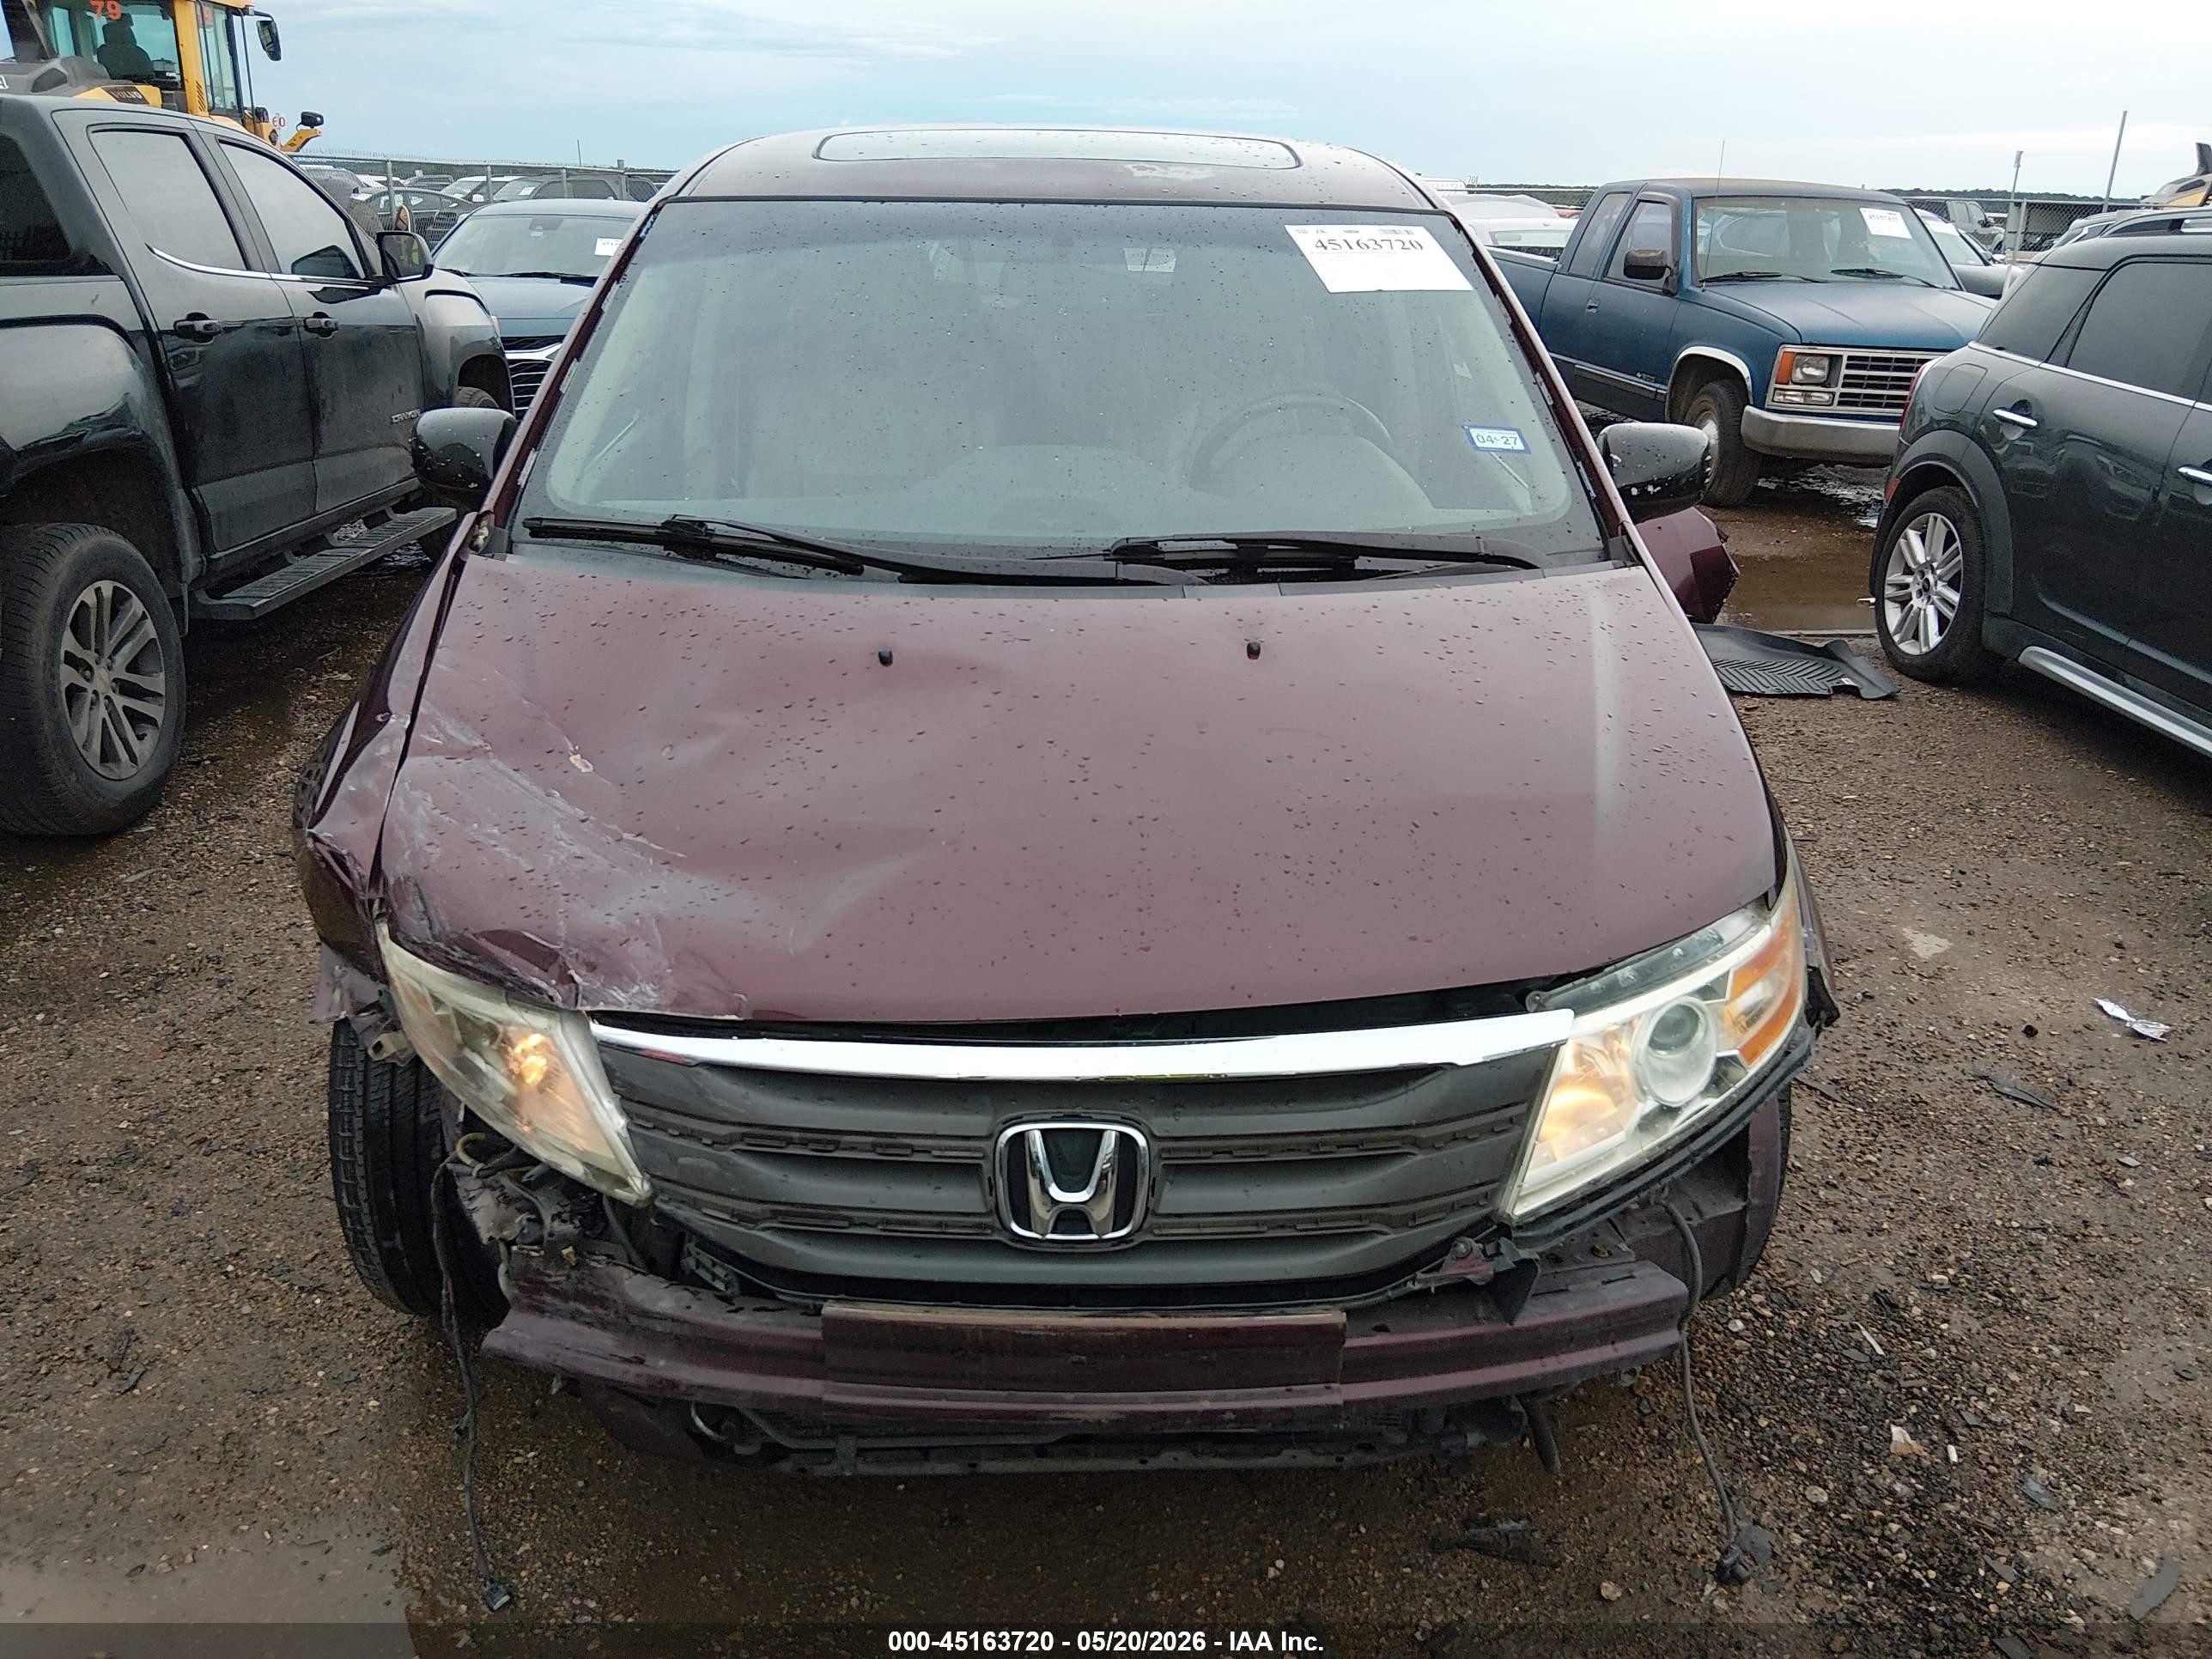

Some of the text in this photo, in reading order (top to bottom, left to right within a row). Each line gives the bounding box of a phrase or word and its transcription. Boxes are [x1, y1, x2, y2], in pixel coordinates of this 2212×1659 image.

[89, 0, 122, 21] 79
[111, 90, 143, 100] VOLVO
[1315, 239, 1424, 251] 45163720
